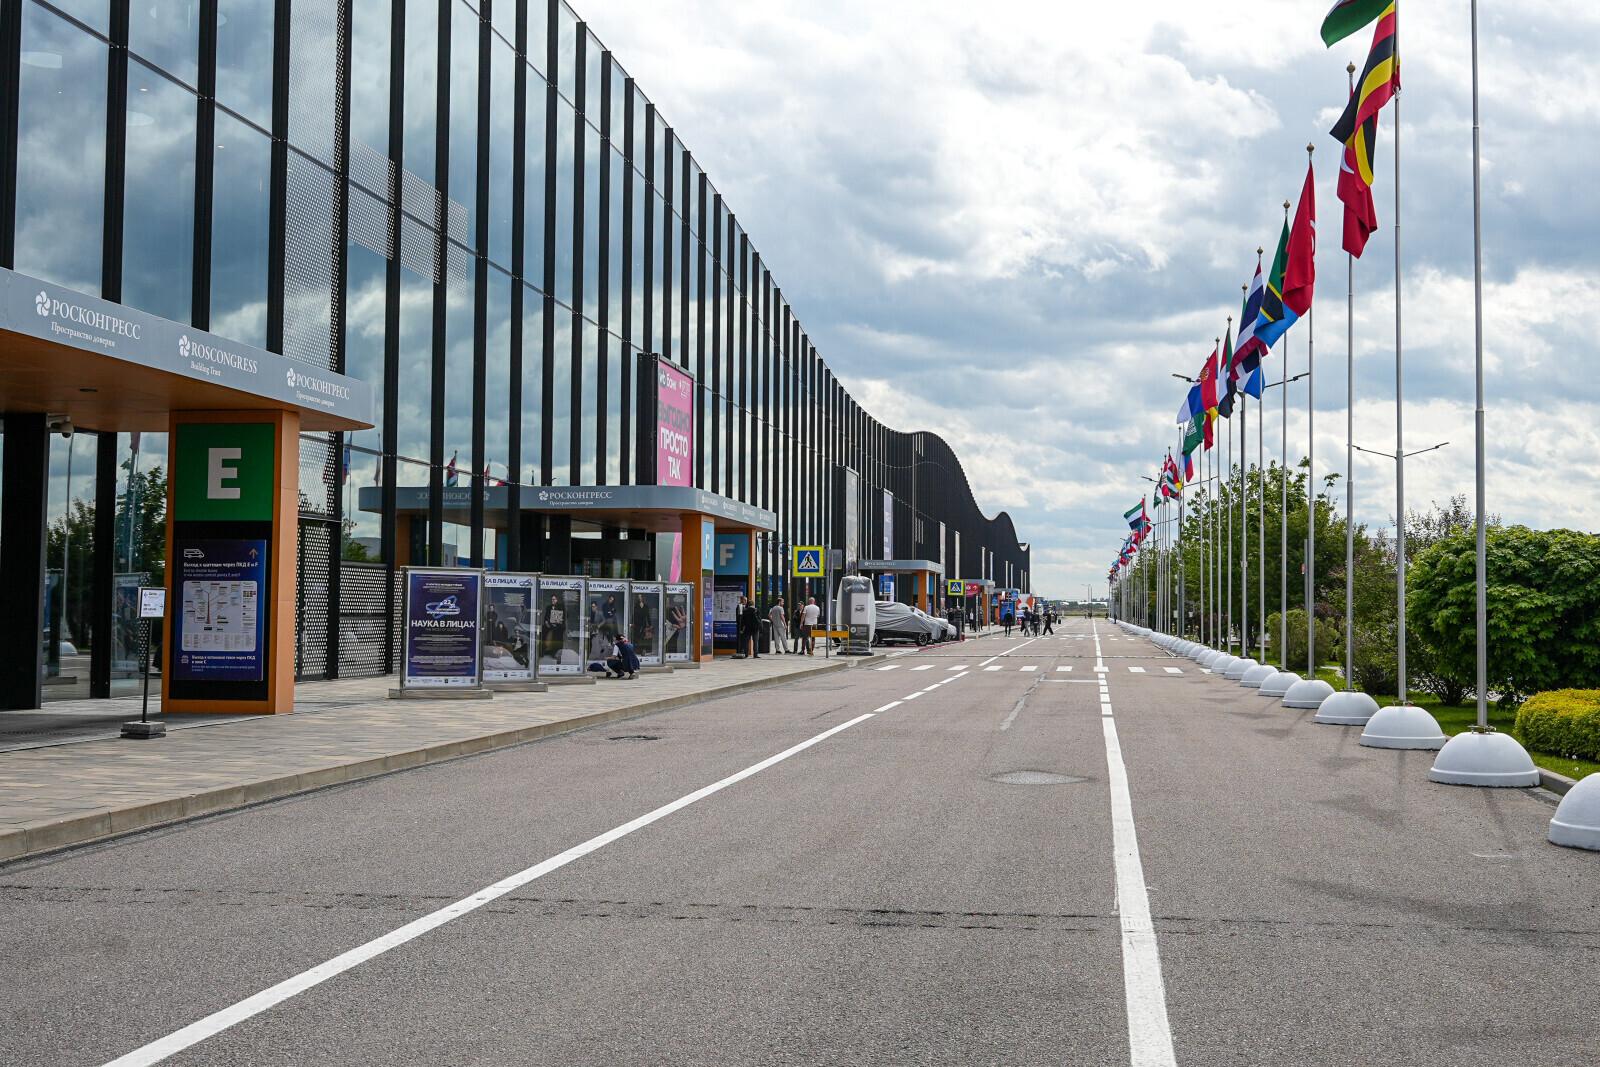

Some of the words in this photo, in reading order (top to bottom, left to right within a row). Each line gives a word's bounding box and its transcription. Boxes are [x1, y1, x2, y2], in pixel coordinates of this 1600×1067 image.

[52, 299, 141, 340] РОСКОНГРЕСС
[51, 321, 93, 341] Пространство
[93, 335, 116, 348] доверия
[190, 360, 210, 376] Building
[191, 341, 258, 374] ROSCONGRESS
[296, 374, 350, 400] РОСКОНГРЕСС
[661, 426, 689, 458] ПРОСТО
[207, 447, 242, 500] E
[668, 456, 681, 480] ТАК
[549, 492, 613, 500] РОСКОНГРЕСС
[720, 543, 735, 566] F
[411, 620, 439, 628] НАУКА
[446, 620, 475, 629] ЛИЦАХ
